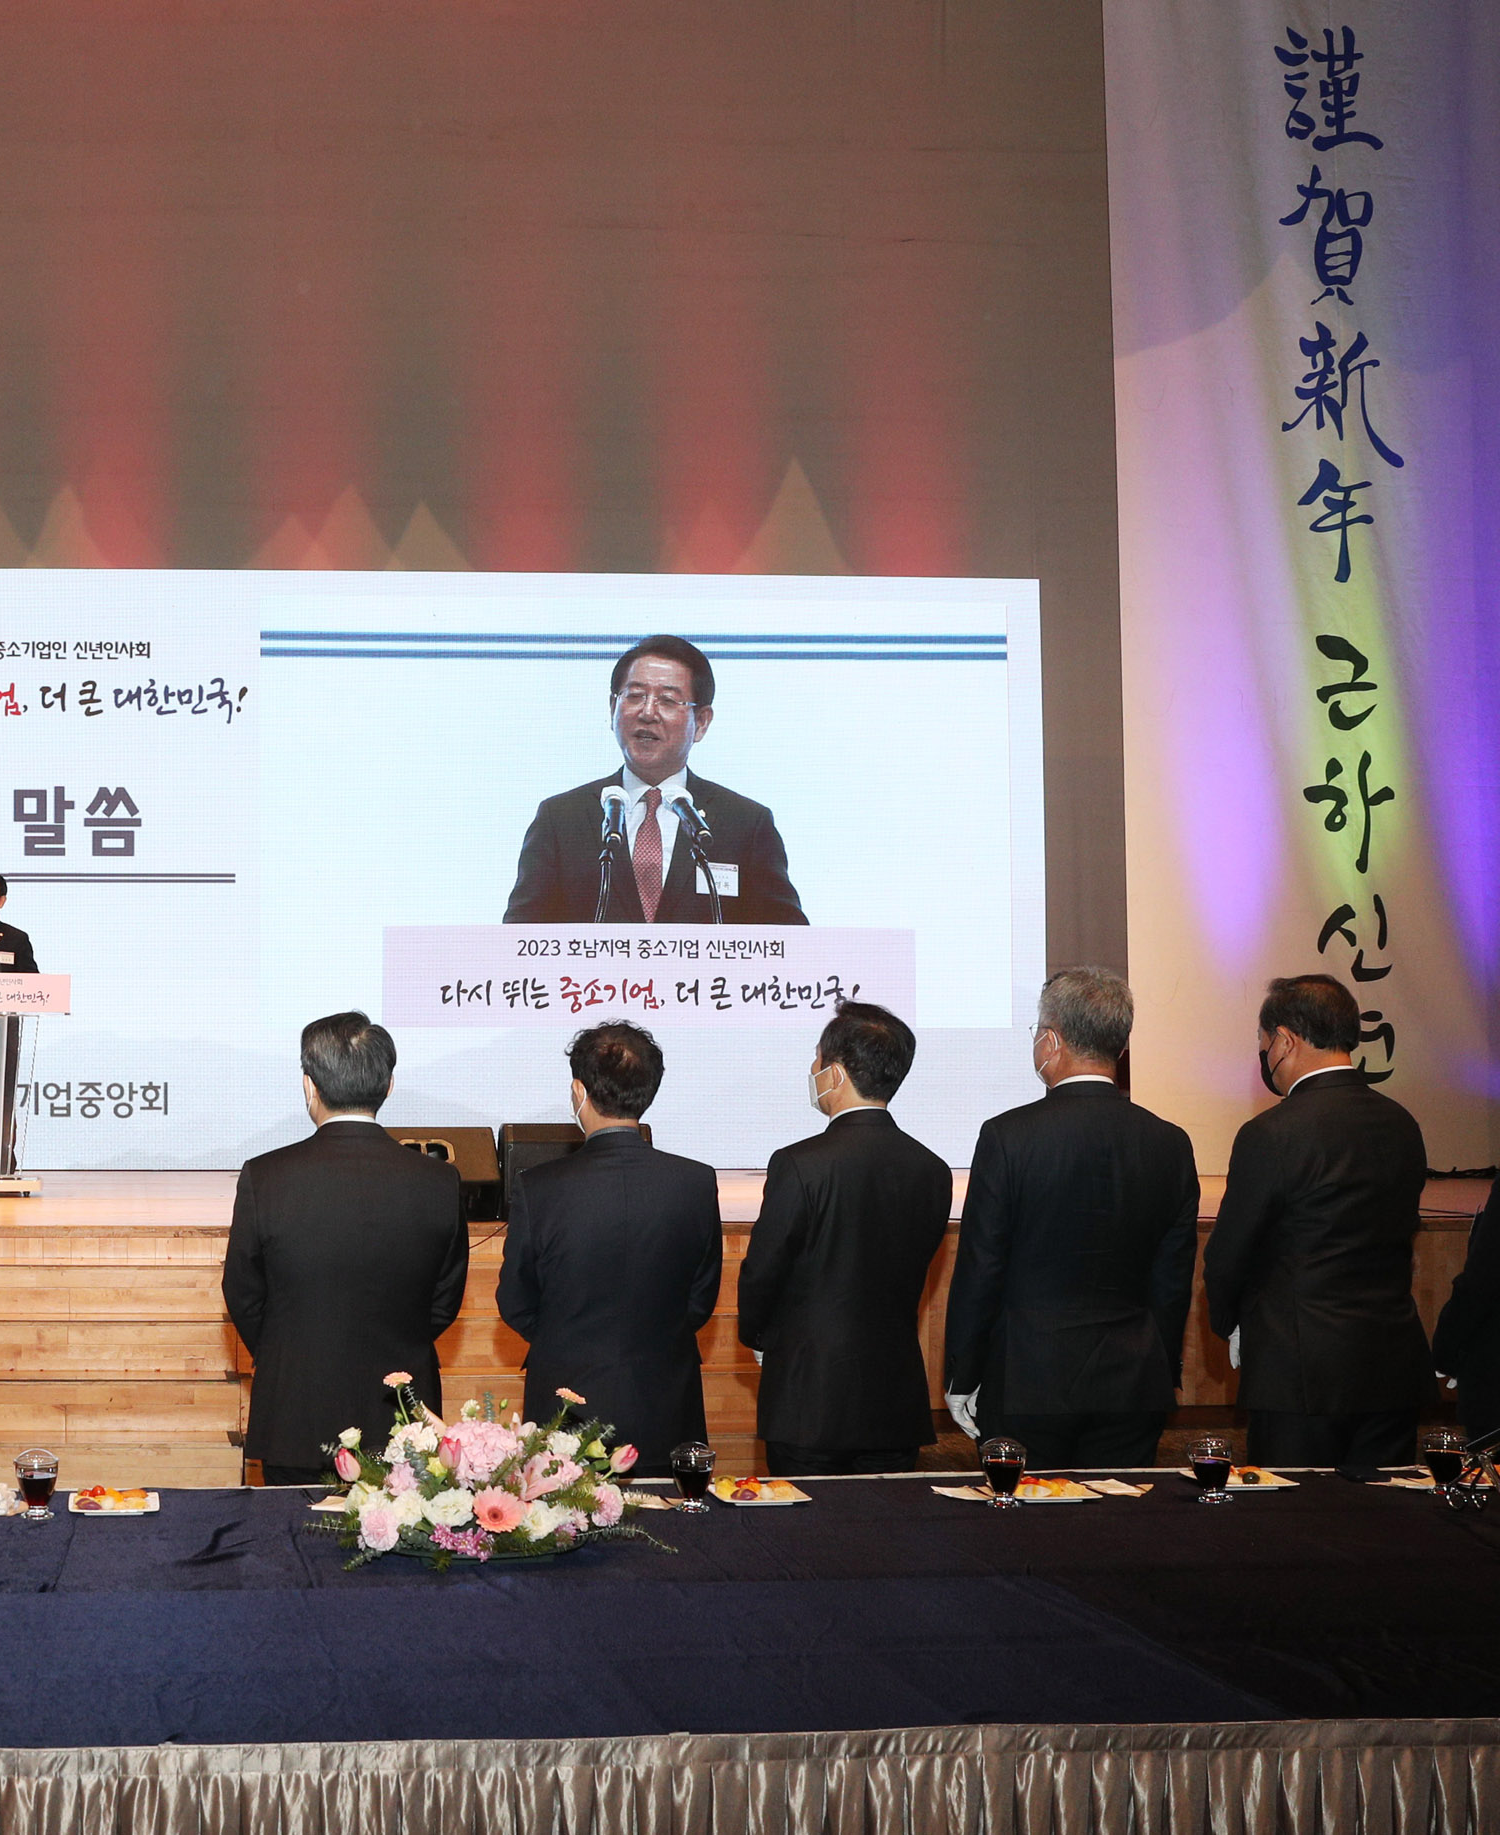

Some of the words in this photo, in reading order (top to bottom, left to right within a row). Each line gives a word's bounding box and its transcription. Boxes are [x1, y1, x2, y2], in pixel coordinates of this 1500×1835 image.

[1274, 25, 1405, 583] 謹賀新年
[73, 640, 151, 660] 신년인사회
[39, 682, 67, 713] 더
[78, 680, 104, 717] 큰
[113, 677, 248, 724] 대한민국!
[517, 939, 561, 957] 2023
[567, 938, 631, 959] 호남지역
[637, 939, 699, 960] 중소기업
[706, 939, 785, 960] 신년인사회
[440, 979, 492, 1008] 다시
[503, 978, 550, 1010] 뛰는
[560, 976, 666, 1014] 중소기업,
[675, 979, 699, 1006] 더
[710, 977, 733, 1010] 큰
[18, 1082, 169, 1119] 기업중앙회
